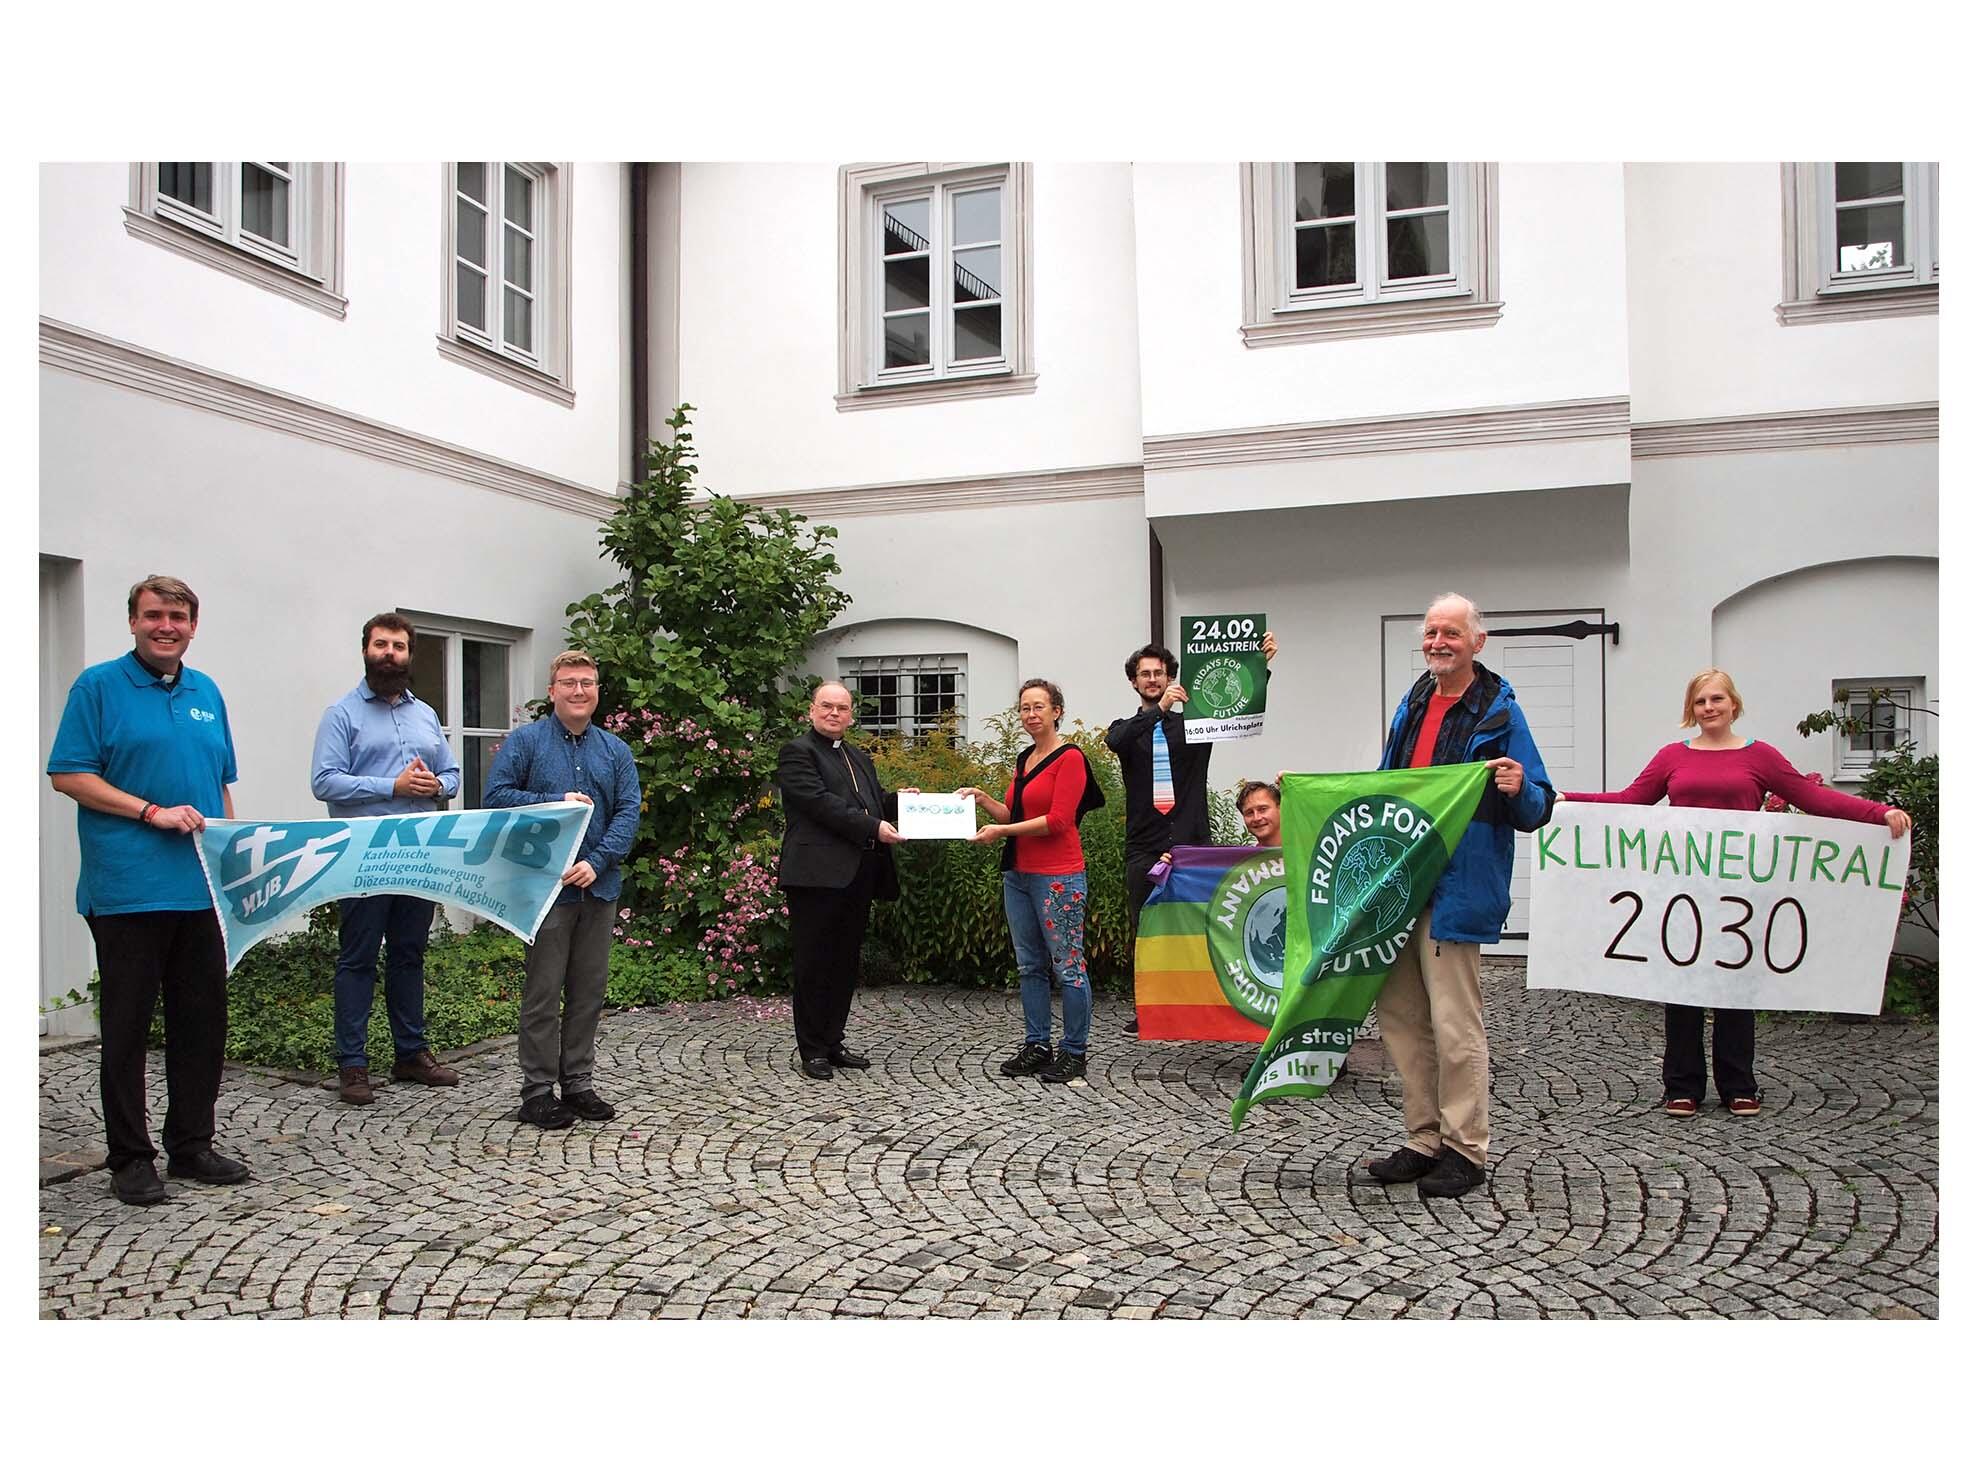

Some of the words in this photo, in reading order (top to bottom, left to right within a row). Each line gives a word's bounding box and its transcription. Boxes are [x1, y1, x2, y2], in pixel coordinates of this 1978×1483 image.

[1192, 619, 1258, 640] 24.09.
[1187, 641, 1260, 654] KLIMASTREIK
[1193, 658, 1221, 690] FRIDAYS
[1223, 658, 1241, 671] FOR
[1213, 695, 1249, 718] FUTURE
[1185, 726, 1204, 736] 16:00
[1206, 726, 1218, 734] Uhr
[1220, 721, 1263, 732] Ulrichsplatz
[362, 849, 431, 860] Katholische
[368, 812, 560, 869] KLJB
[1311, 803, 1374, 904] FRIDAYS
[1537, 824, 1903, 890] KLIMANEUTRAL
[357, 863, 486, 888] Landjugendbewegung
[354, 875, 451, 894] Diözesanverband
[454, 883, 507, 917] Augsburg
[1217, 858, 1285, 930] RMANY
[1604, 890, 1808, 974] 2030
[1224, 959, 1278, 1016] UTURE
[1288, 1058, 1319, 1076] Ihr
